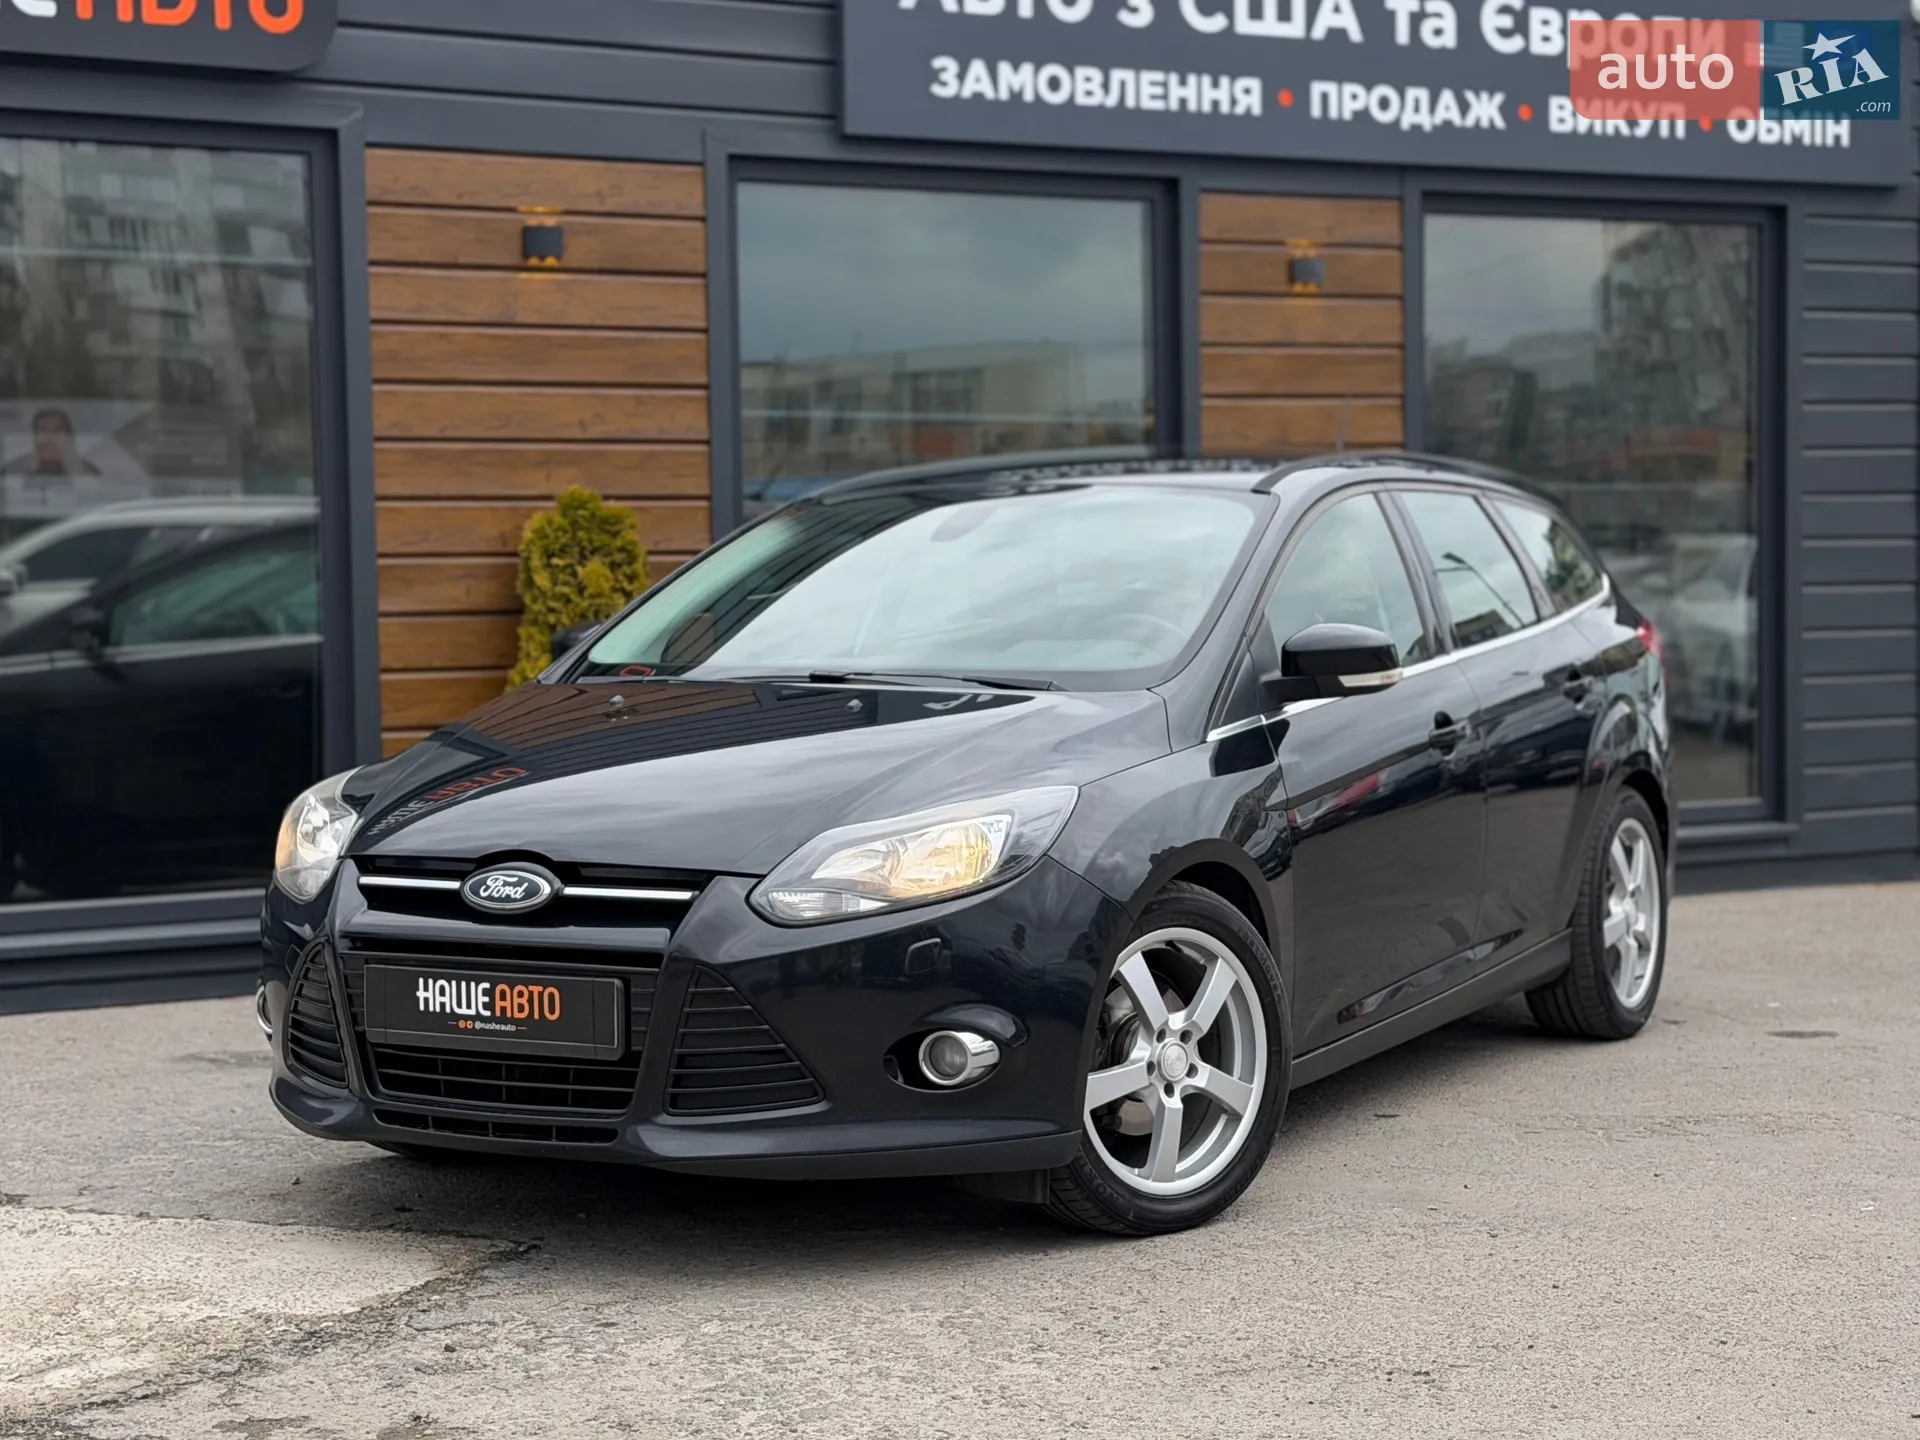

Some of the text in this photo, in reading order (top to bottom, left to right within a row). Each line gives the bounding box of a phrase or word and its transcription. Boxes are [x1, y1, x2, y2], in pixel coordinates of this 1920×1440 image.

[1178, 0, 1365, 43] США
[1384, 0, 1458, 49] та
[930, 55, 1852, 149] ЗАМОВЛЕННЯ ПРОДАЖ ВИКУП ОБМІН
[479, 874, 529, 900] Ford
[474, 1020, 517, 1032] @nasheauto
